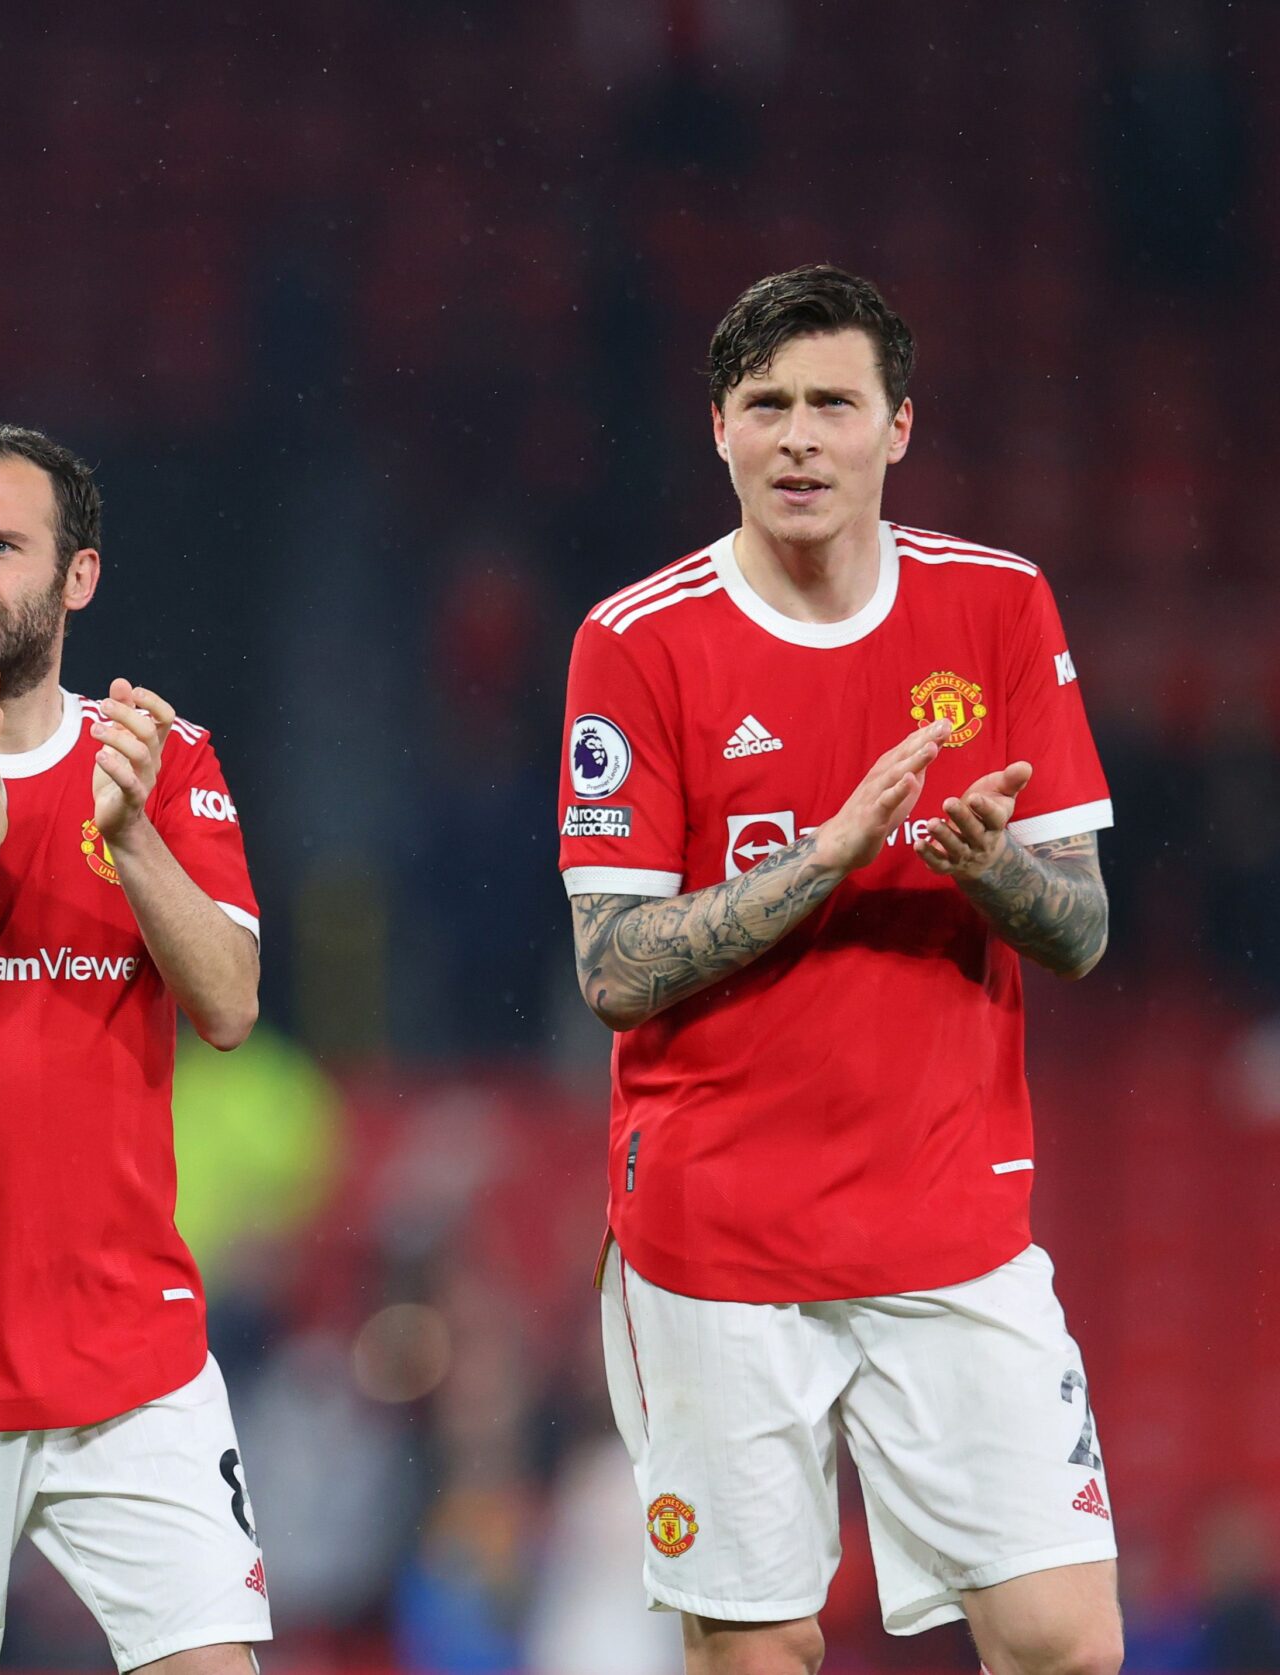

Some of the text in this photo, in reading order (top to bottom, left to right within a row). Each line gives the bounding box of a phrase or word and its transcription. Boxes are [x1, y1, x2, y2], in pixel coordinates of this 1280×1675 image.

[916, 676, 977, 702] MANCHESTER
[948, 728, 973, 742] ITED
[723, 738, 783, 760] adidas
[586, 780, 609, 790] Premier
[190, 787, 238, 823] KOH
[579, 808, 623, 823] room
[579, 822, 630, 837] racism
[98, 864, 119, 880] UNI
[649, 1498, 691, 1518] MANCHESTER
[657, 1541, 688, 1553] UNITED
